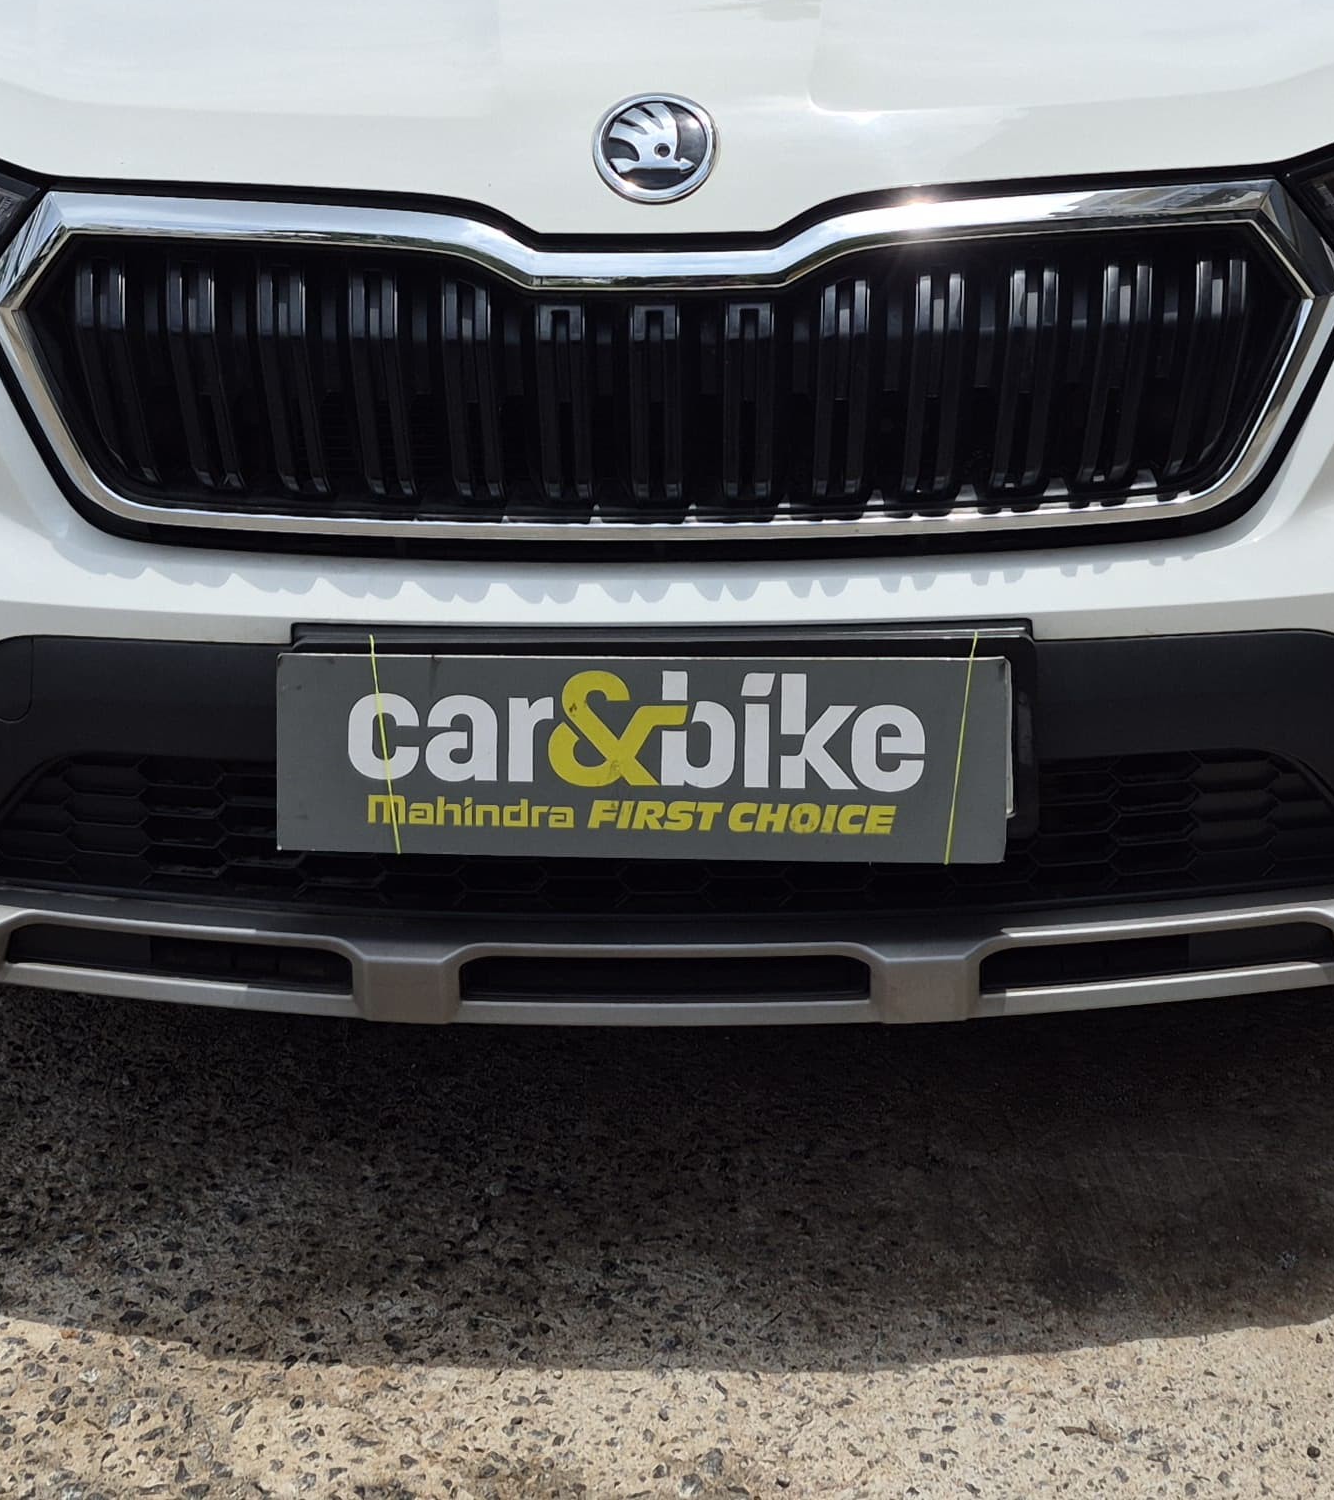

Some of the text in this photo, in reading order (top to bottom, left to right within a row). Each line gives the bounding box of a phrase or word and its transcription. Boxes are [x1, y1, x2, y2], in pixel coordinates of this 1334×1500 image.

[347, 669, 927, 794] car&bike
[367, 793, 898, 836] Mahindra FIRST CHOICE
